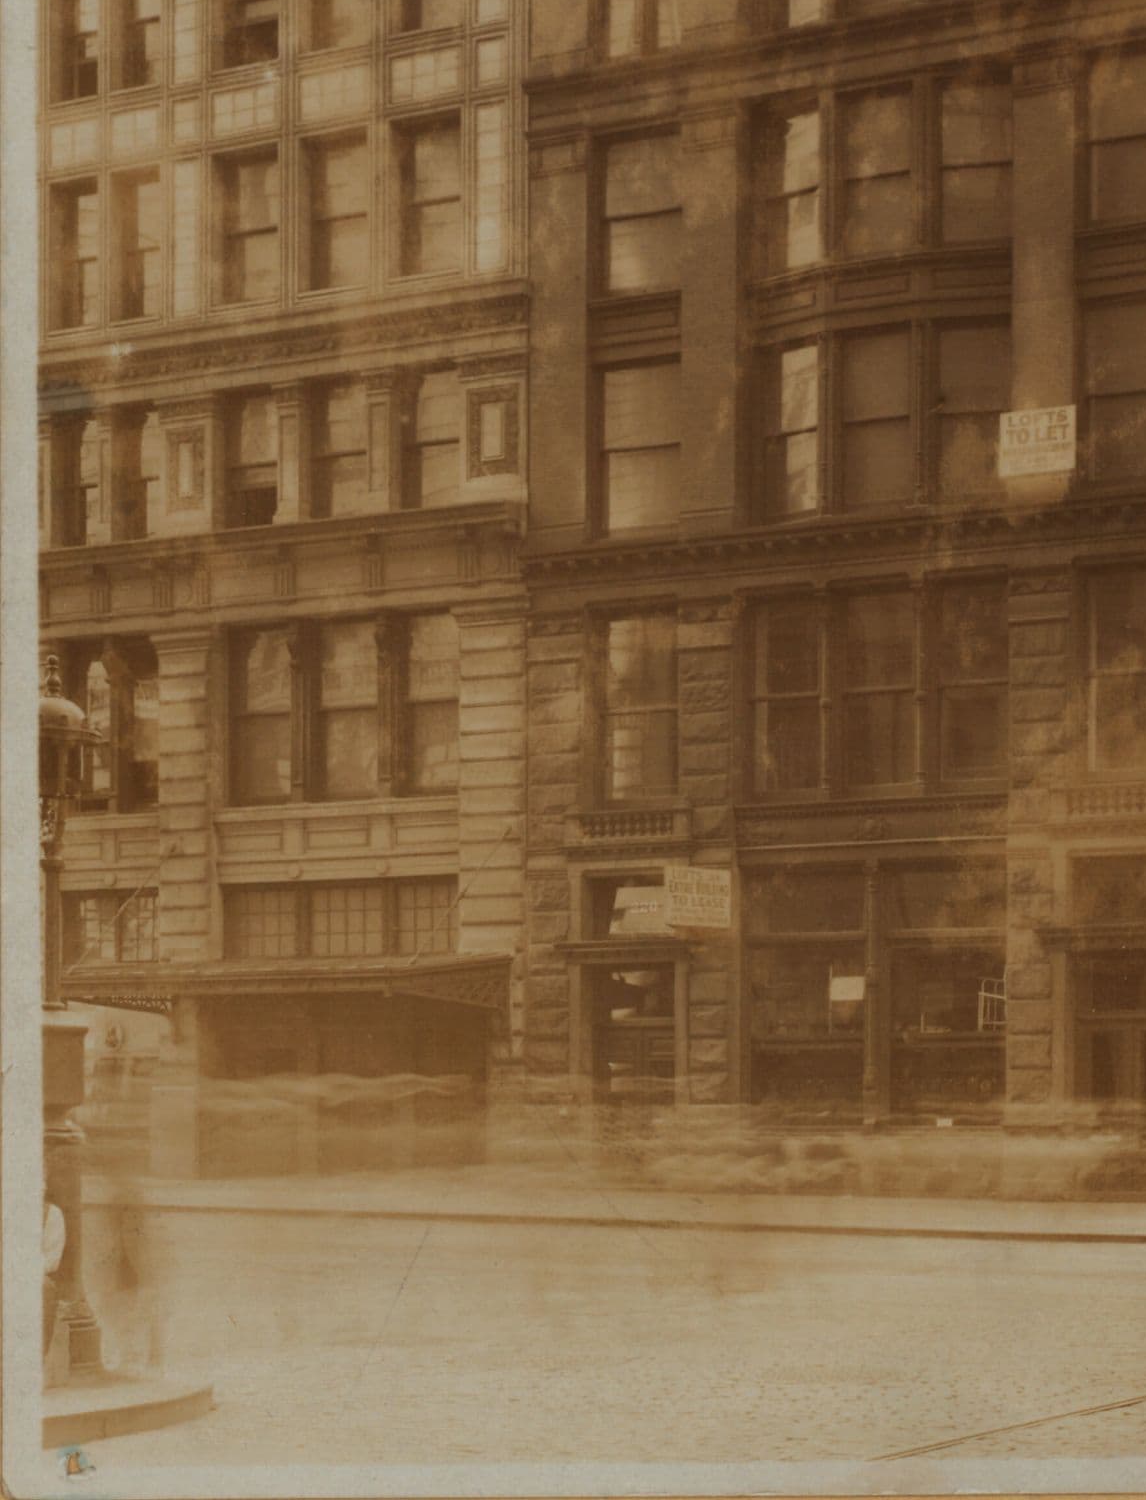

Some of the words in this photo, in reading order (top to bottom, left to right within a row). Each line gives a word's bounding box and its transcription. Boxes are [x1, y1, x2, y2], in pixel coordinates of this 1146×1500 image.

[1007, 409, 1069, 428] LOFTS
[1006, 428, 1030, 445] TO
[1035, 423, 1070, 443] LET
